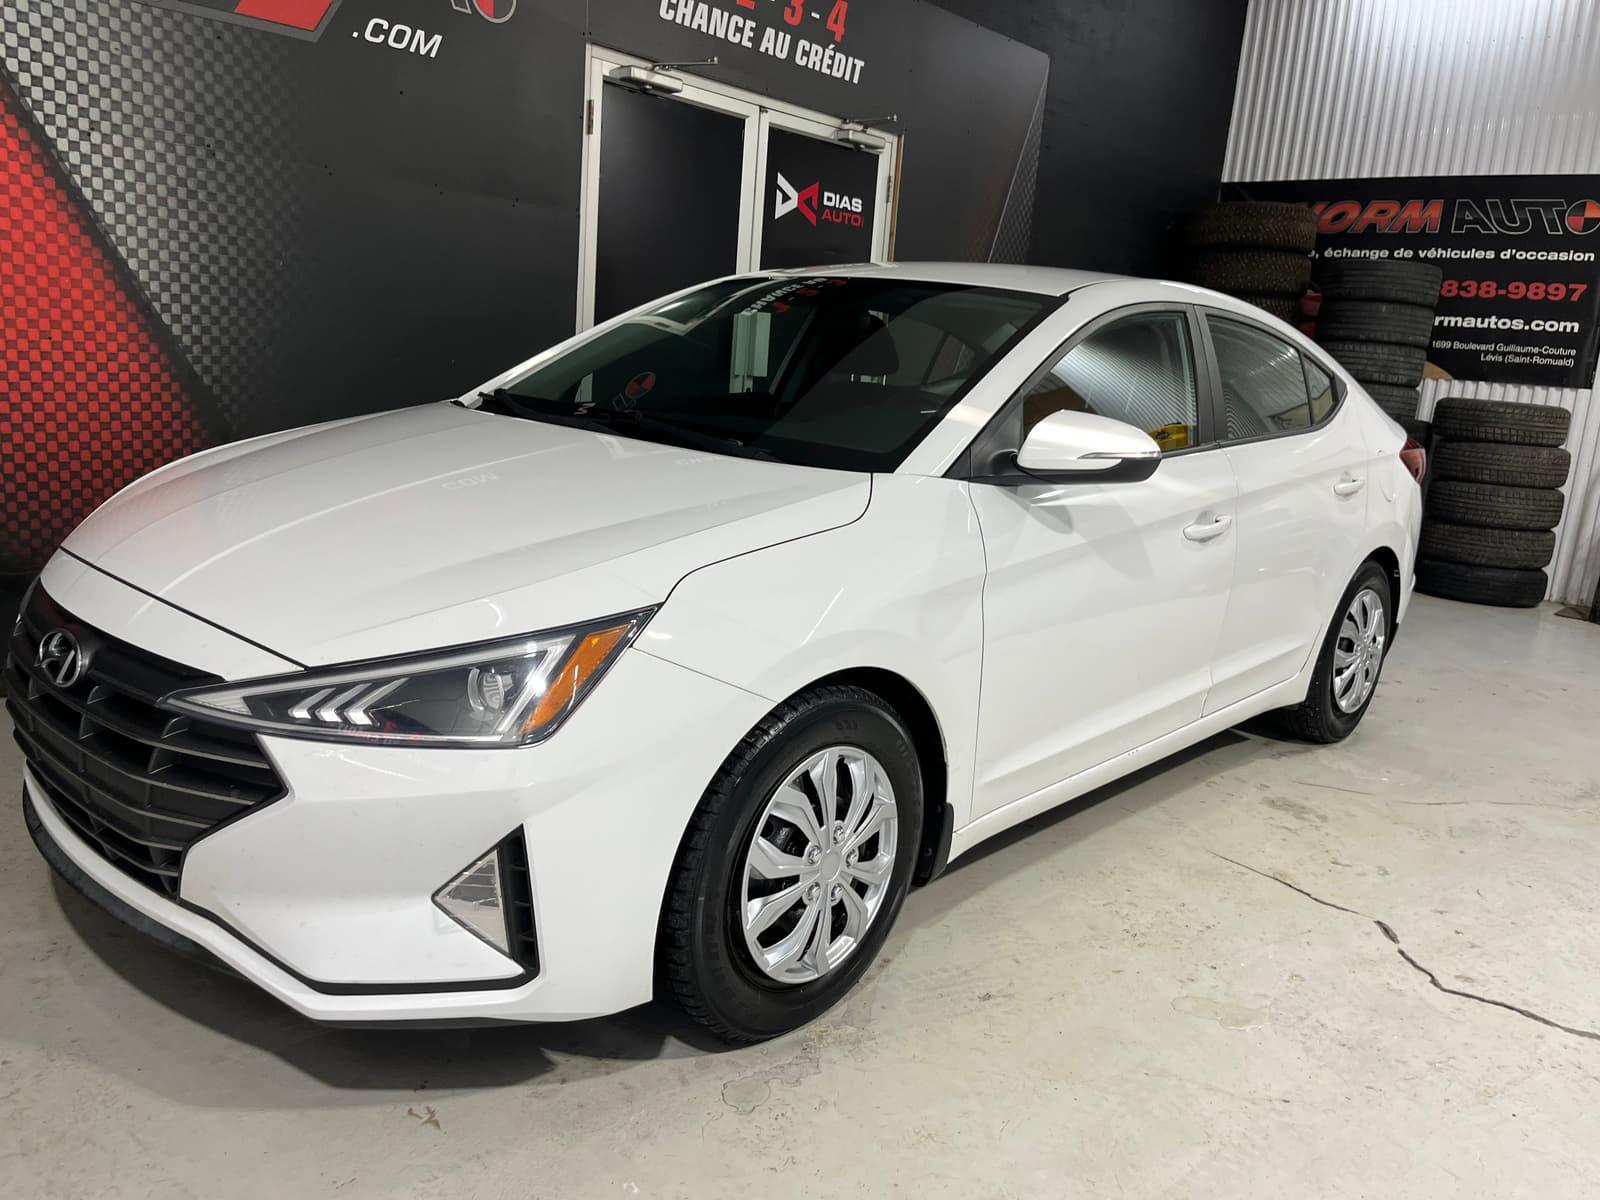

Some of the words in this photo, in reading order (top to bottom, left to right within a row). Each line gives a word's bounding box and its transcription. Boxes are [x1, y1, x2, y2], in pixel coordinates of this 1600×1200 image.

[826, 0, 848, 42] 4
[352, 17, 443, 58] .COM
[659, 0, 756, 48] CHANCE
[759, 27, 791, 60] AU
[795, 39, 865, 84] CRÉDIT
[823, 191, 862, 212] DIAS
[822, 208, 861, 227] AUTO
[1313, 200, 1444, 234] ORM
[1451, 199, 1600, 235] AUTO
[1324, 247, 1389, 260] échange
[1393, 248, 1413, 259] de
[1418, 247, 1495, 260] véhicules
[1500, 248, 1595, 262] d'occasion
[1440, 280, 1587, 301] 838-9897
[1434, 315, 1579, 333] rmautos.com
[1432, 340, 1451, 349] 1699
[1453, 341, 1494, 351] Boulevard
[1496, 344, 1576, 356] Guillaume-Couture
[1480, 352, 1503, 362] Lévis
[1504, 355, 1574, 367] (Saint-Romuald)
